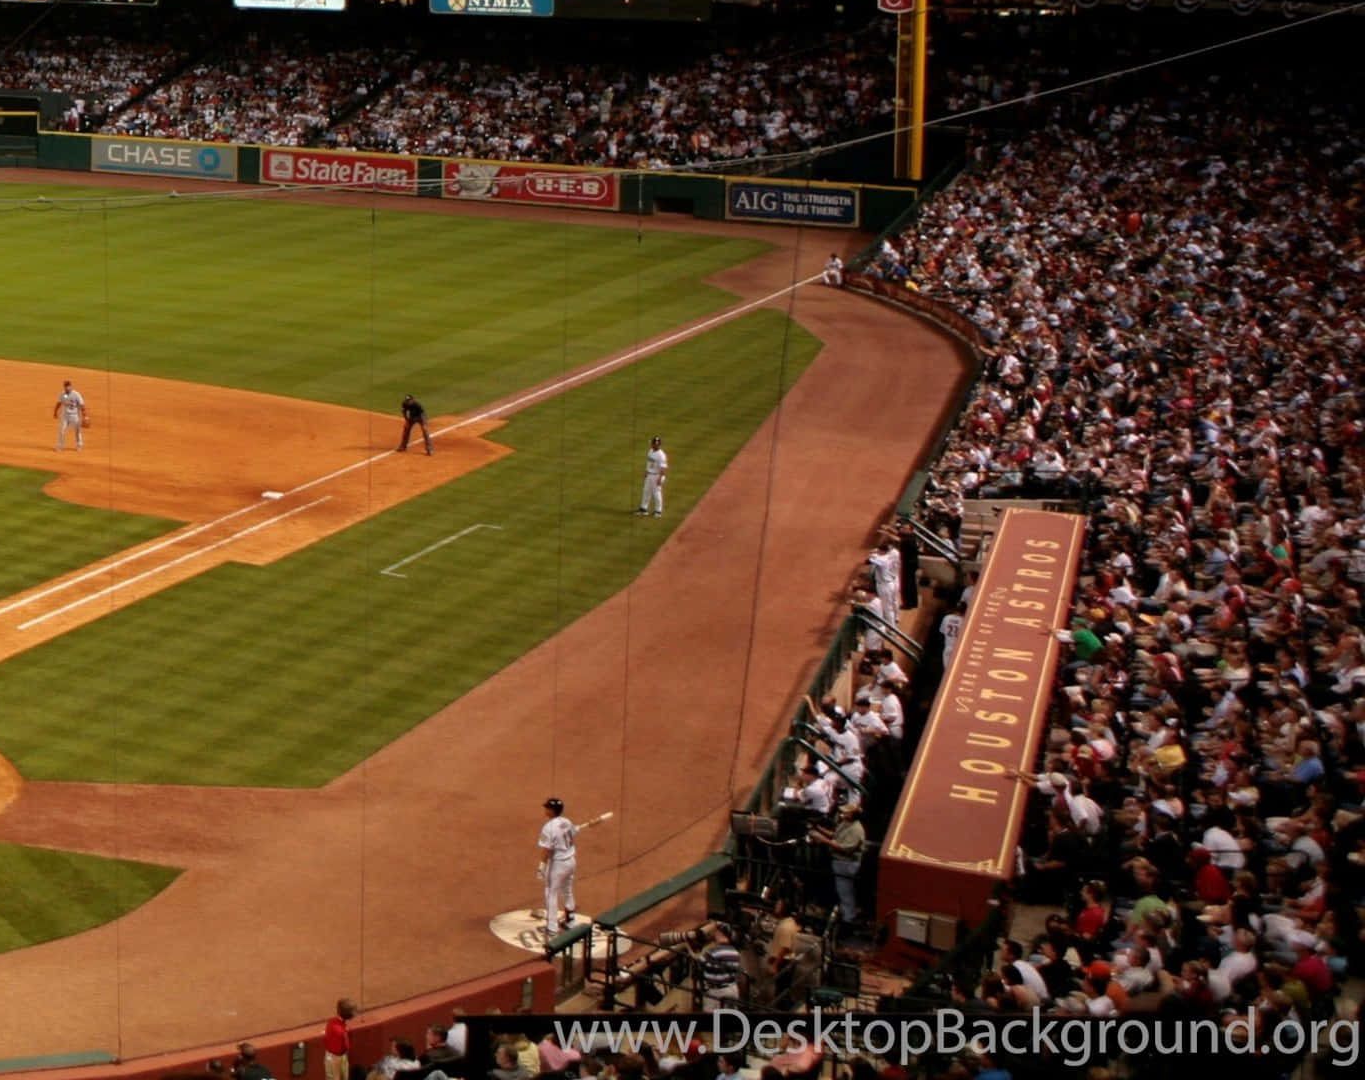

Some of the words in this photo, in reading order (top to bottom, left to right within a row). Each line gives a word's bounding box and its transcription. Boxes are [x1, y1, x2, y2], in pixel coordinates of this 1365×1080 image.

[107, 143, 192, 168] CHASE
[735, 191, 777, 211] AIG
[782, 192, 799, 202] THE
[803, 193, 852, 206] STRENGTH
[783, 203, 795, 213] TO
[797, 204, 808, 214] BE
[811, 205, 841, 217] THERE
[949, 647, 1035, 805] HOUSTON
[1003, 538, 1061, 628] ASTROS
